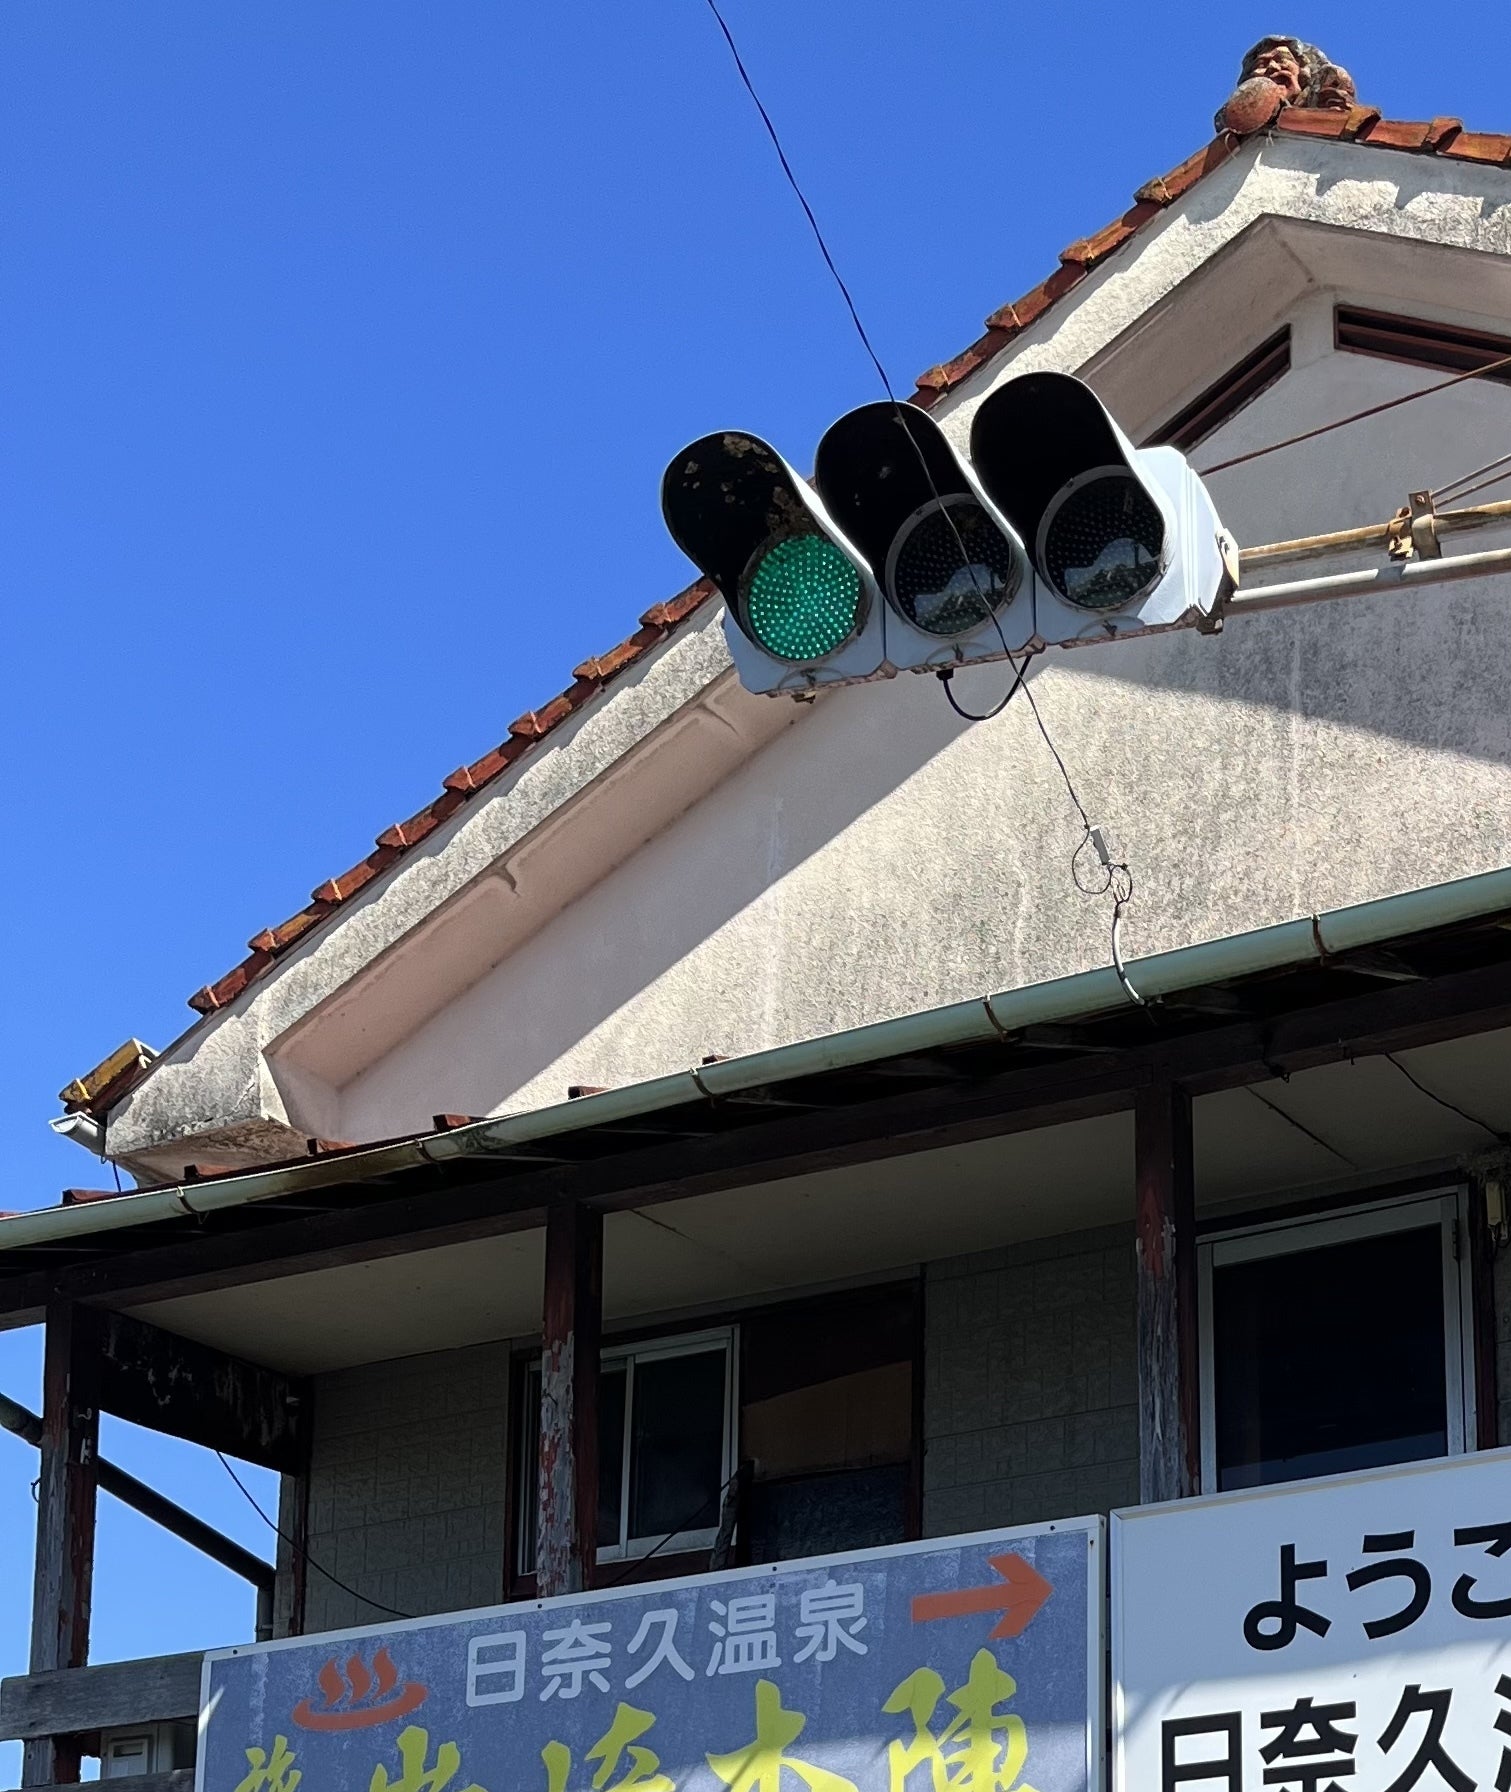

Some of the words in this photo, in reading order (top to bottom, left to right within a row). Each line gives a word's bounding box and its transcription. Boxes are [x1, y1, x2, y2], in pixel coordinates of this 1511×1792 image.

[464, 1578, 868, 1709] 日奈久温泉
